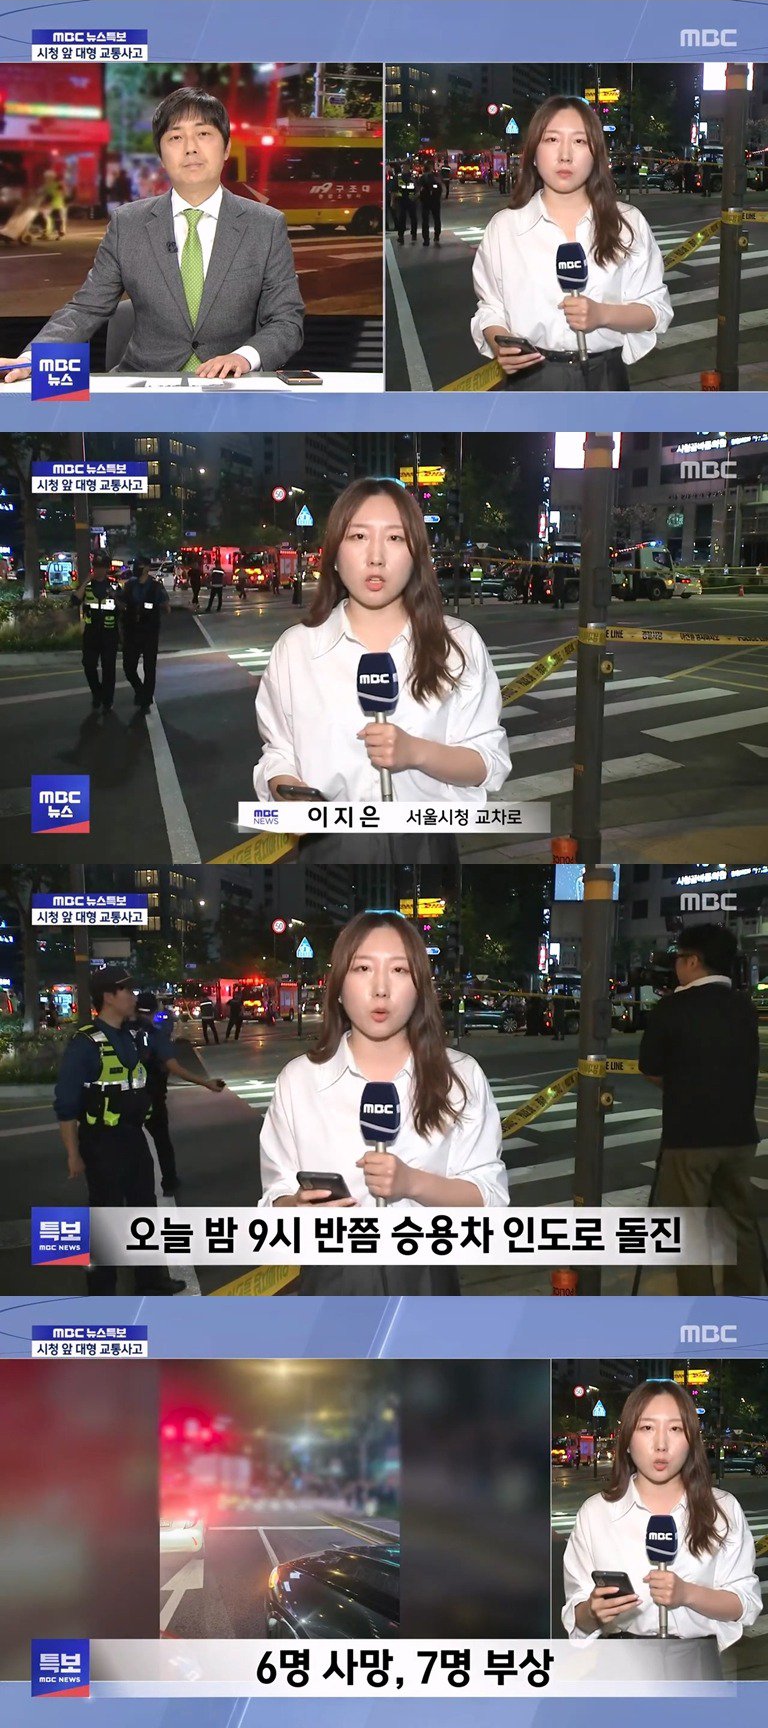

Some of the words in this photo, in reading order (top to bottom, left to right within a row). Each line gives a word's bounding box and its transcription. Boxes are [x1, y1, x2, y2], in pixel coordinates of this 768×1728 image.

[558, 260, 582, 270] MBC
[360, 673, 390, 684] MBC
[363, 1103, 394, 1115] MBC
